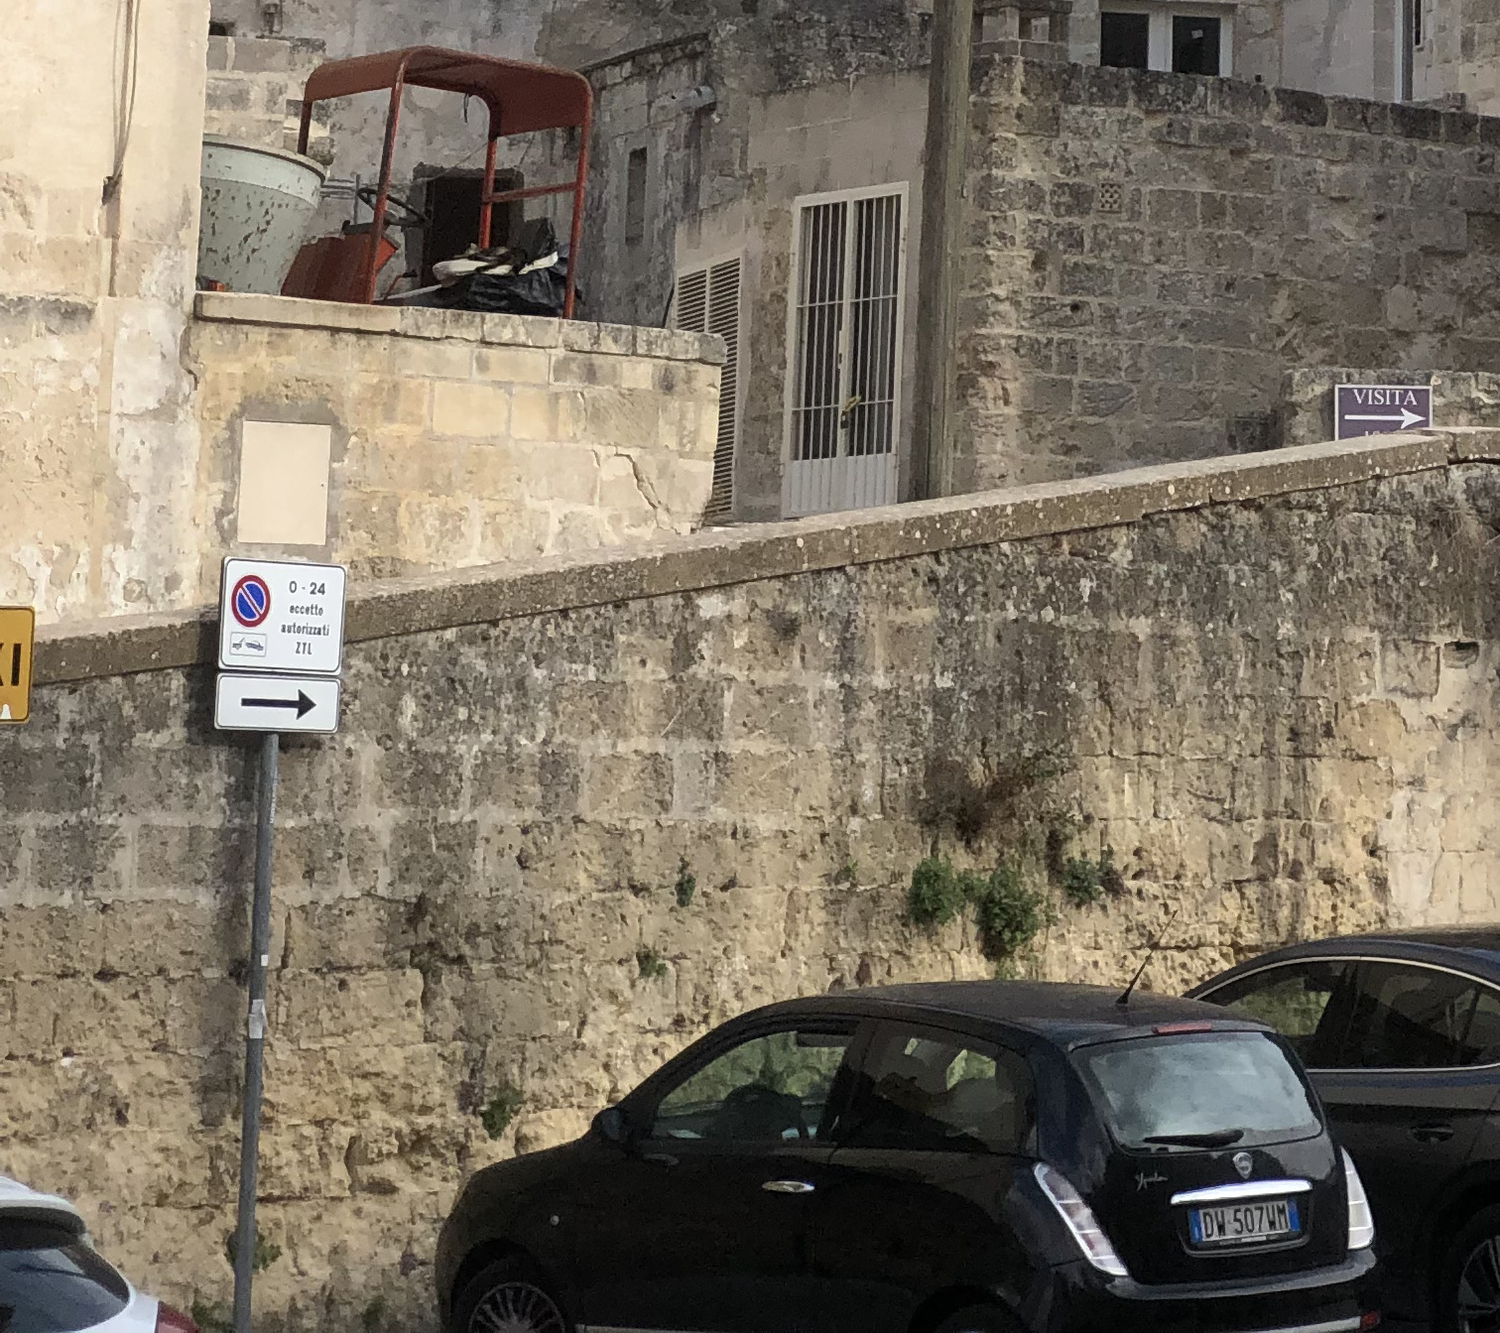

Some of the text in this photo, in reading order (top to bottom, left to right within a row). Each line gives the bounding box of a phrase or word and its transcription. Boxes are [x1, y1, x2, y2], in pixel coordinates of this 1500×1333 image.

[1353, 389, 1417, 405] VISITA
[310, 582, 325, 595] 24
[290, 604, 324, 616] eccetto
[281, 622, 330, 636] autorizzati
[295, 641, 312, 655] ZTL
[1203, 1210, 1226, 1238] DW
[1233, 1203, 1289, 1233] 507WM
